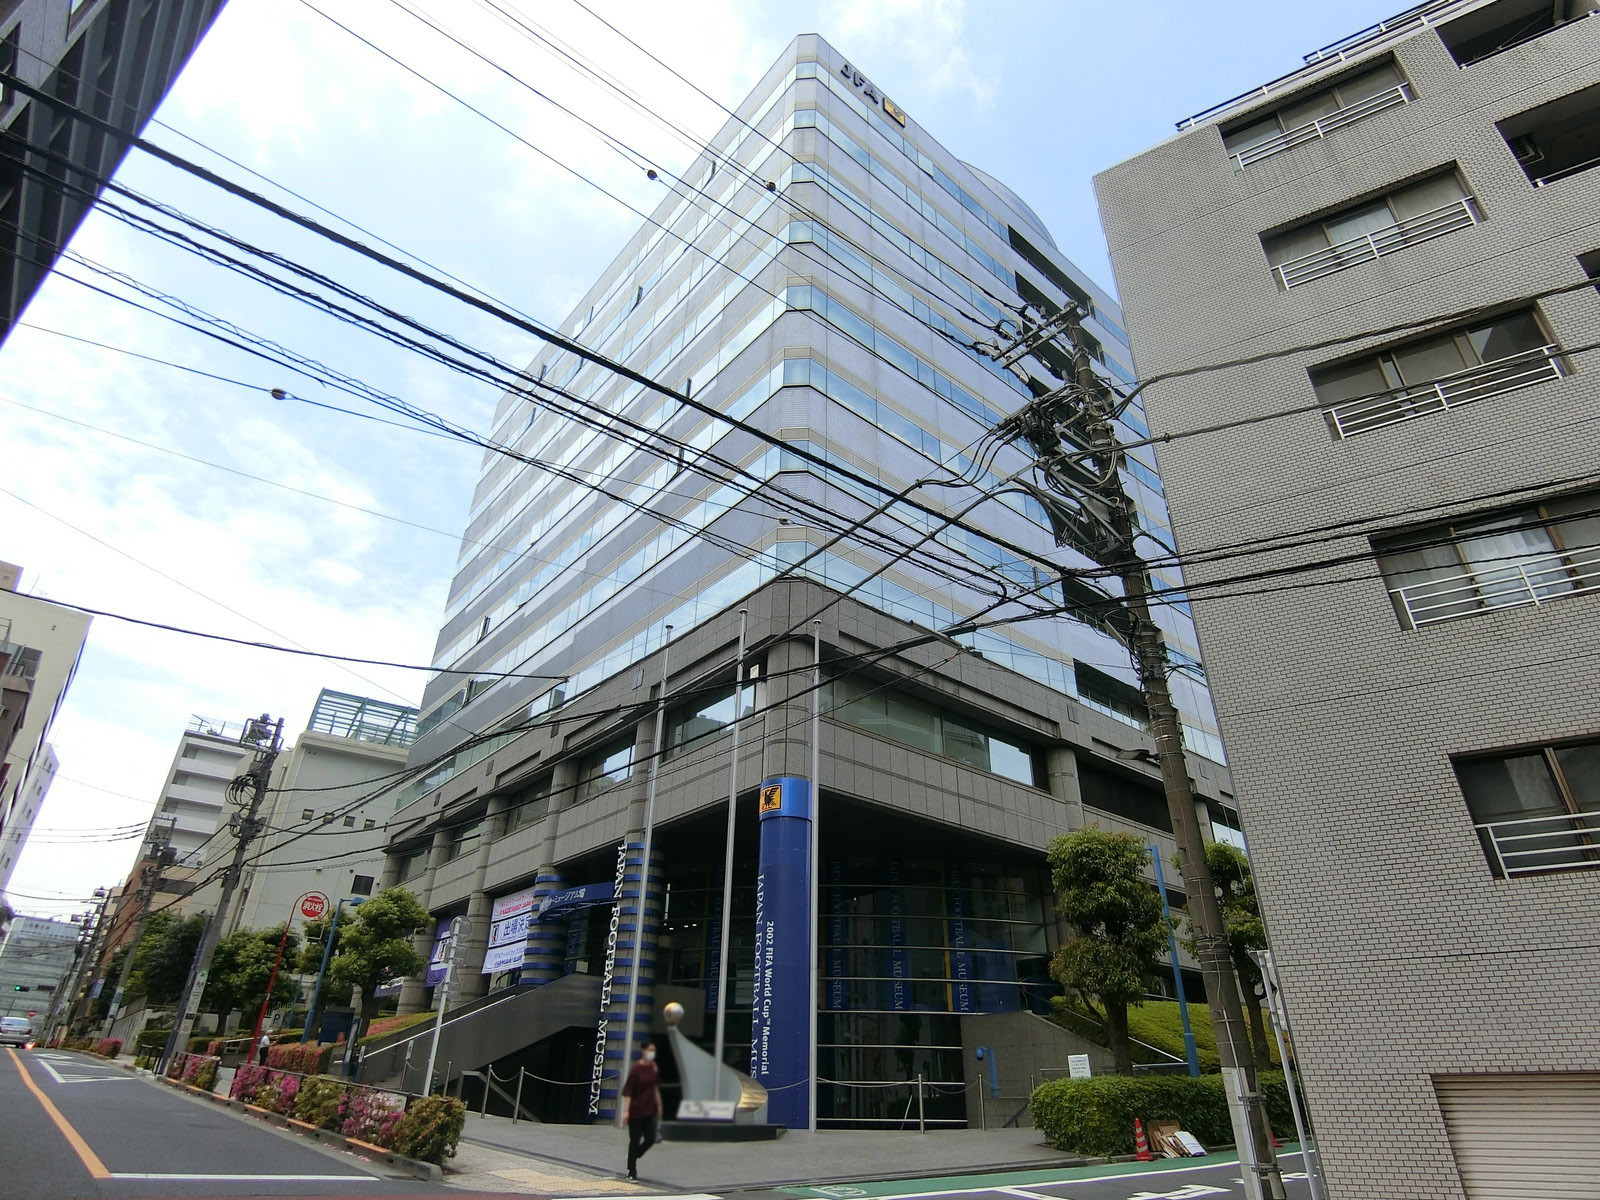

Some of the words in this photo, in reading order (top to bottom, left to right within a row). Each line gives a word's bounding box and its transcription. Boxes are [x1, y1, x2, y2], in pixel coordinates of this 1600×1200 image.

[840, 64, 879, 104] JFA
[613, 842, 628, 899] JAPAN
[756, 873, 765, 926] JAPAN
[765, 921, 775, 945] 2002
[765, 948, 774, 967] FIFA
[600, 905, 621, 1013] FOOTBALL
[751, 931, 763, 1031] FOOTBALL
[764, 968, 773, 997] World
[832, 959, 842, 1009] MUSEUM
[892, 960, 904, 1010] MUSEUM
[958, 962, 969, 1011] MUSEUM
[588, 1019, 609, 1115] MUSEUM
[750, 1038, 758, 1079] MUS
[761, 1026, 770, 1075] Memorial
